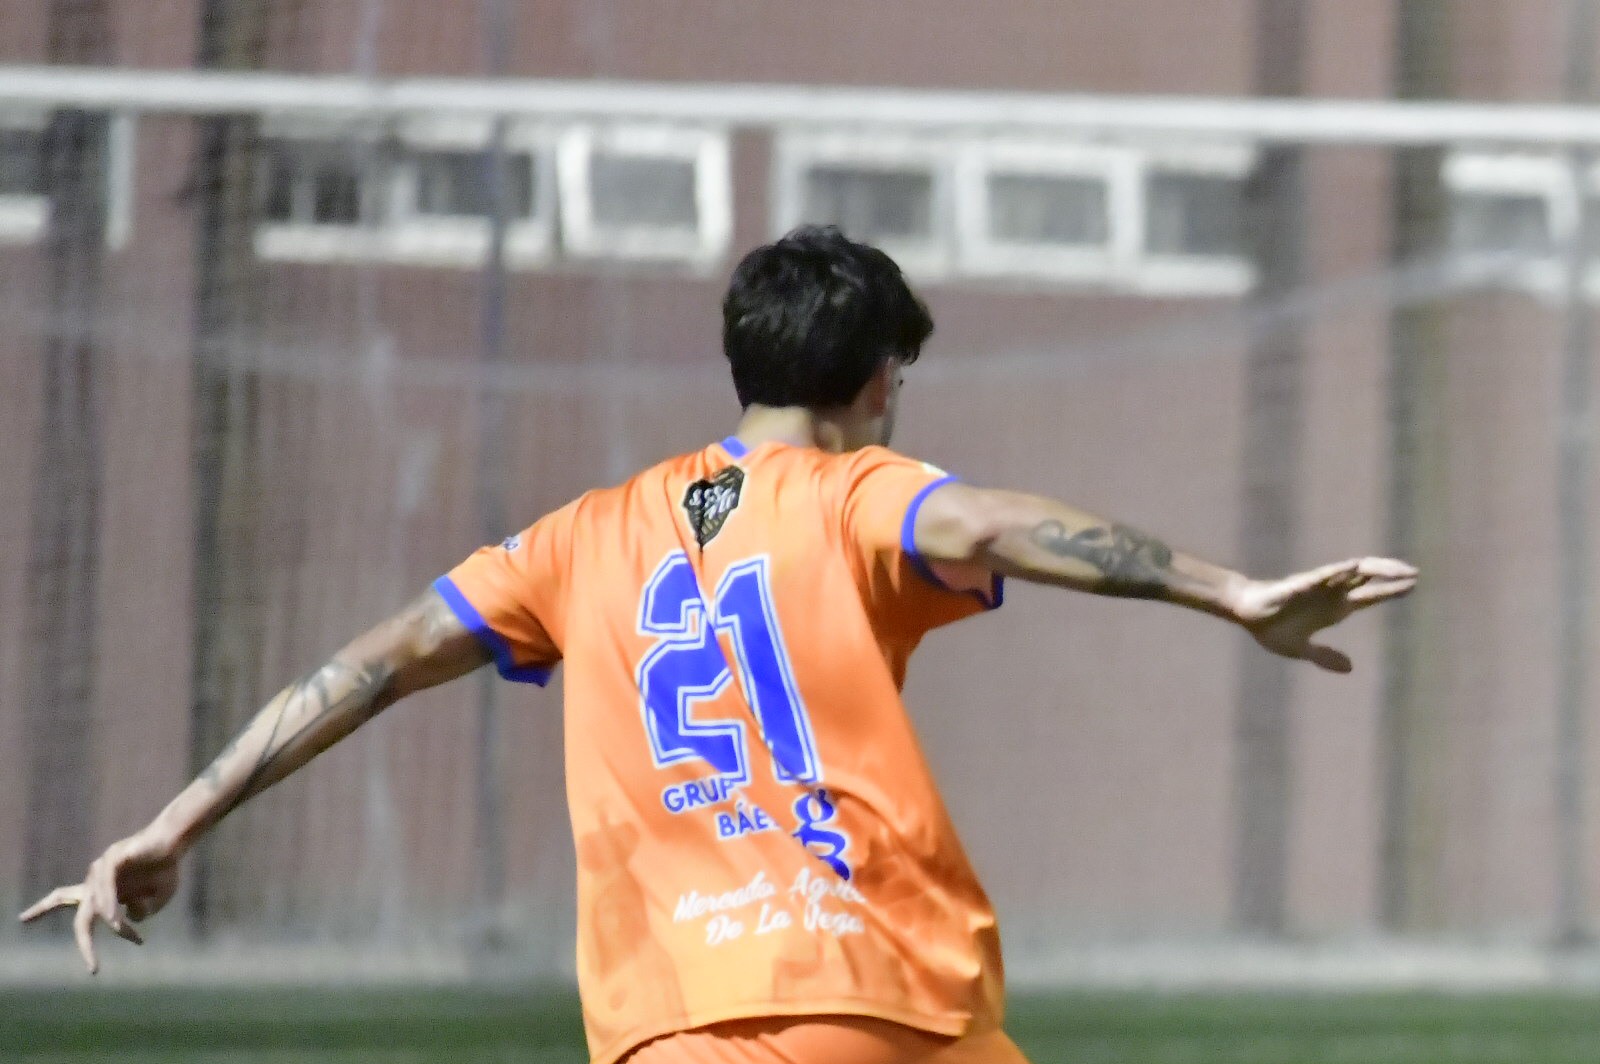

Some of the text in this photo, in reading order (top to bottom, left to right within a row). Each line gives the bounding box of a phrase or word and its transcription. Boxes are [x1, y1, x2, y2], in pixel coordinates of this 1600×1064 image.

[637, 550, 822, 782] 21
[662, 778, 735, 813] GRUP
[716, 801, 779, 838] BÁE
[754, 903, 792, 935] La
